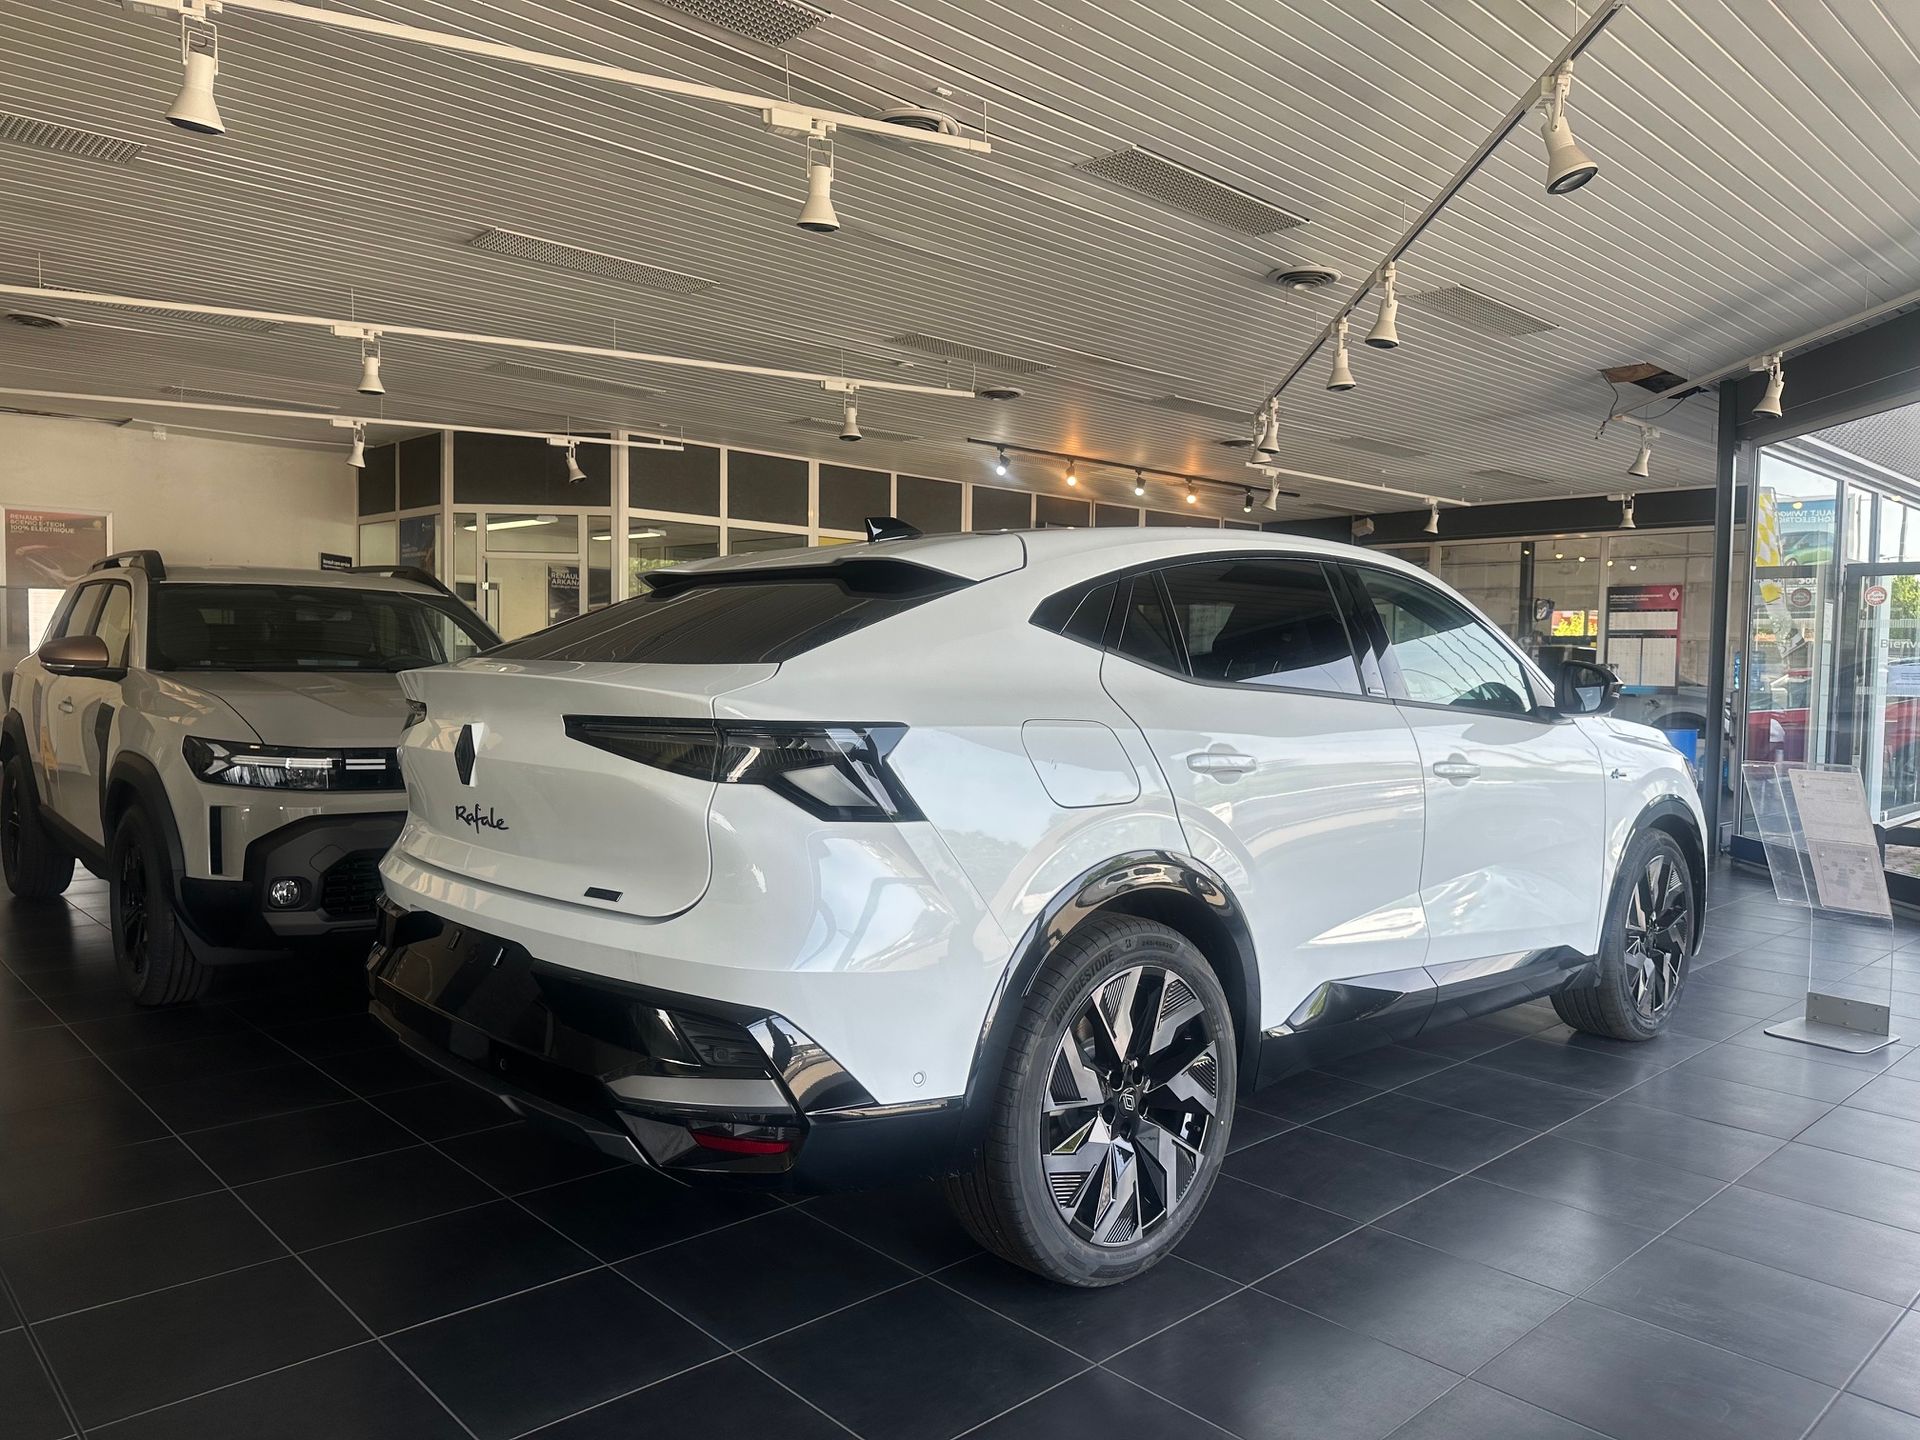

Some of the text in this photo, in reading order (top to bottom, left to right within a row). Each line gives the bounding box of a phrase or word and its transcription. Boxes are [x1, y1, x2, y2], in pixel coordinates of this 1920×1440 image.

[9, 513, 43, 521] RENAULT
[1880, 639, 1920, 649] Bienv
[455, 803, 510, 834] Rafale
[1053, 949, 1115, 1024] BRIDGESTONE
